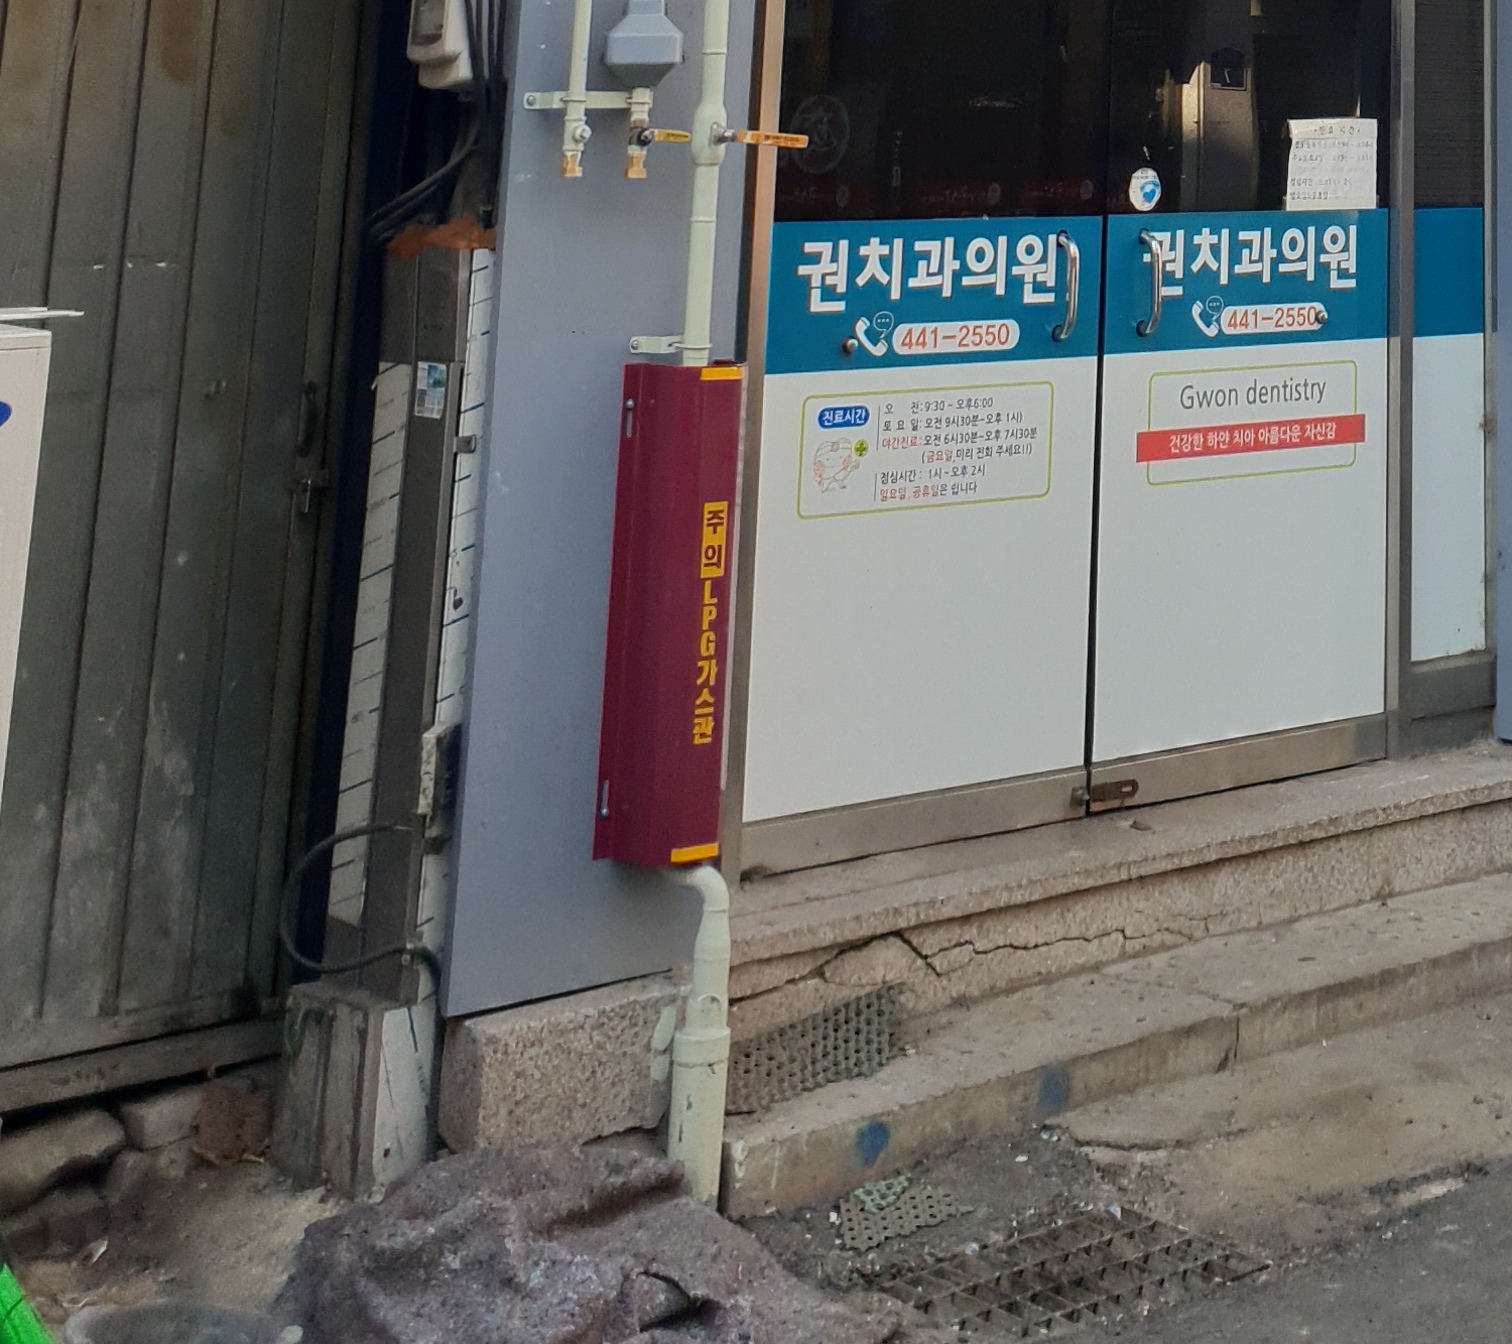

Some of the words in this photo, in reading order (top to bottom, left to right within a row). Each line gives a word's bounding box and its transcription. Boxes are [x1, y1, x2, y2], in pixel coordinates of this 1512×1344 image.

[798, 234, 1057, 312] 권치과의원
[1143, 225, 1357, 297] 권치과의원
[1227, 306, 1317, 330] 441-2550
[900, 324, 1011, 350] 441-2550
[1180, 384, 1239, 410] Gwon
[1246, 378, 1327, 406] dentistry
[822, 408, 867, 426] 진료시간
[1169, 434, 1204, 454] 건강한
[1207, 431, 1231, 450] 하얀
[1233, 429, 1256, 448] 치아
[1258, 425, 1302, 445] 아름다운
[1304, 422, 1337, 441] 자신감
[704, 510, 725, 569] 주의
[693, 579, 718, 745] LPG가스관
